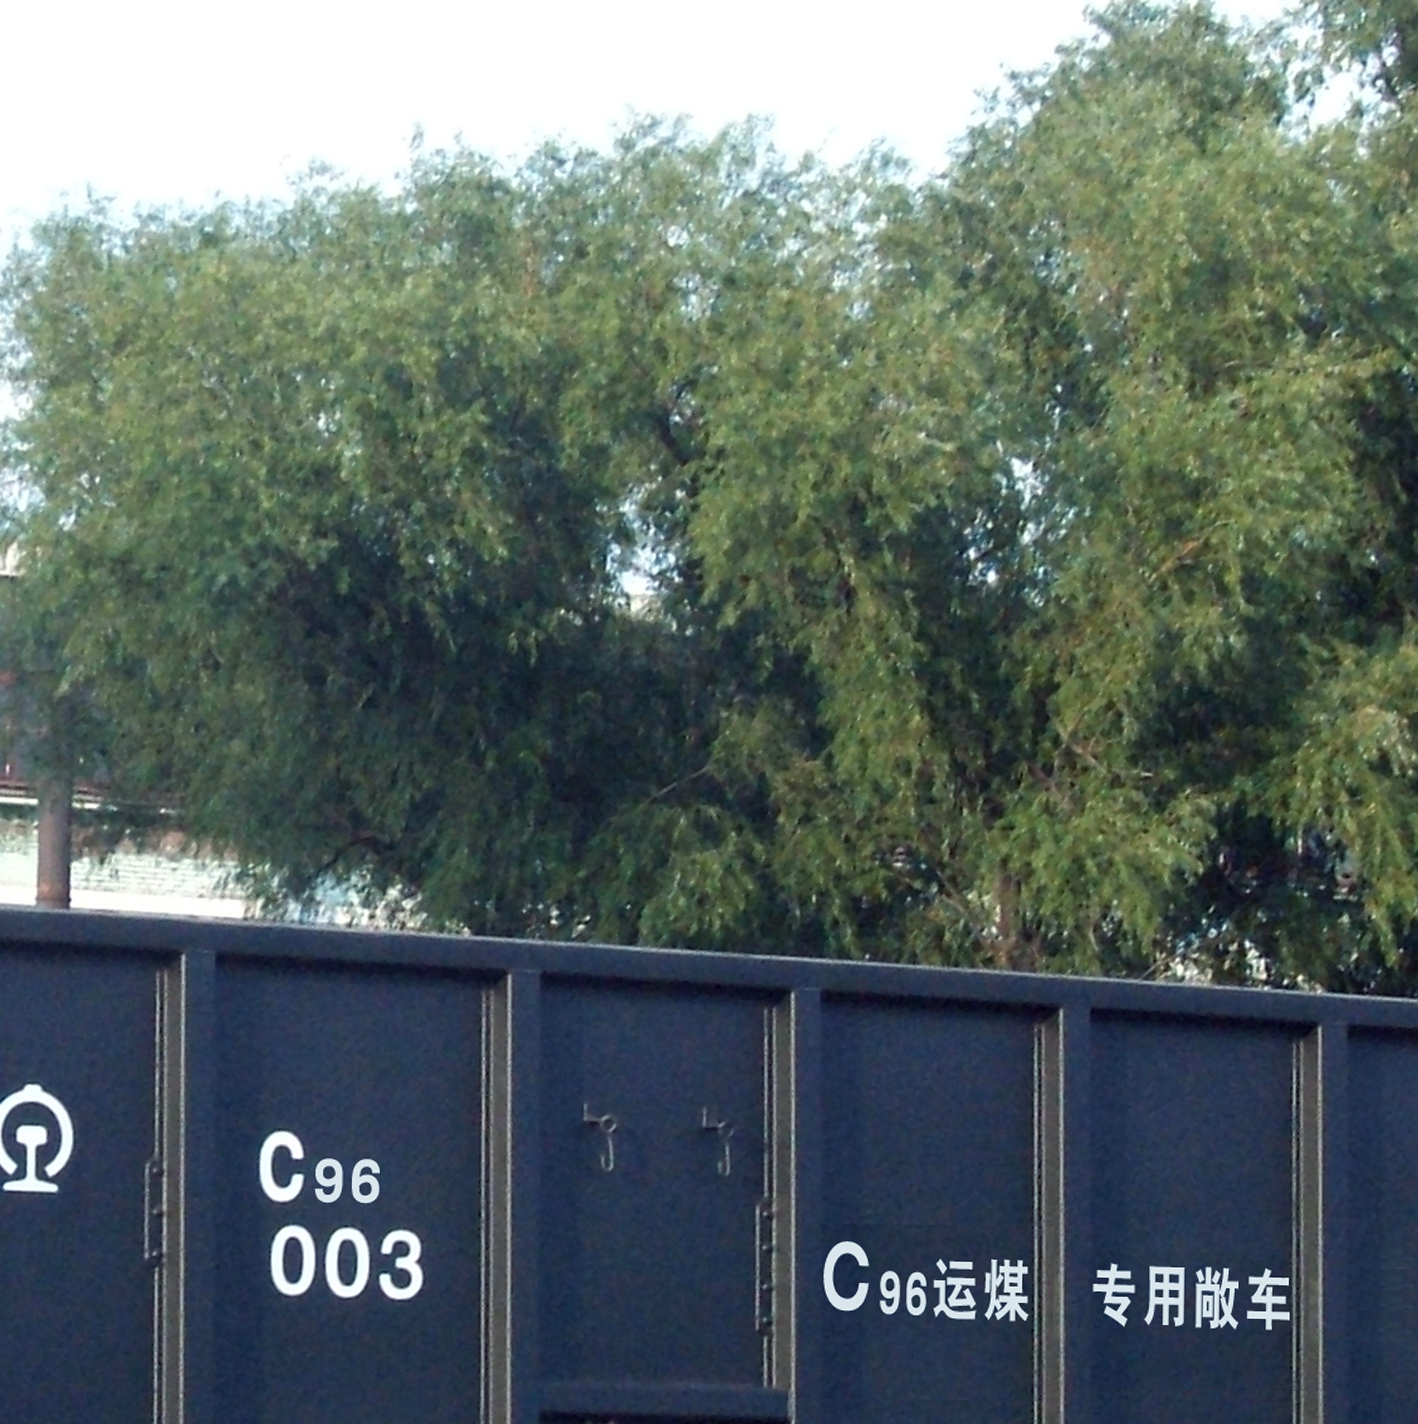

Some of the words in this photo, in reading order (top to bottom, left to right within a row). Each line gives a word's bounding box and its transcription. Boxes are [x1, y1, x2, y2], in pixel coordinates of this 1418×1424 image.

[258, 1129, 381, 1204] C96
[270, 1224, 424, 1300] 003
[822, 1240, 1029, 1322] C96运煤
[1092, 1263, 1291, 1331] 专用敞车
